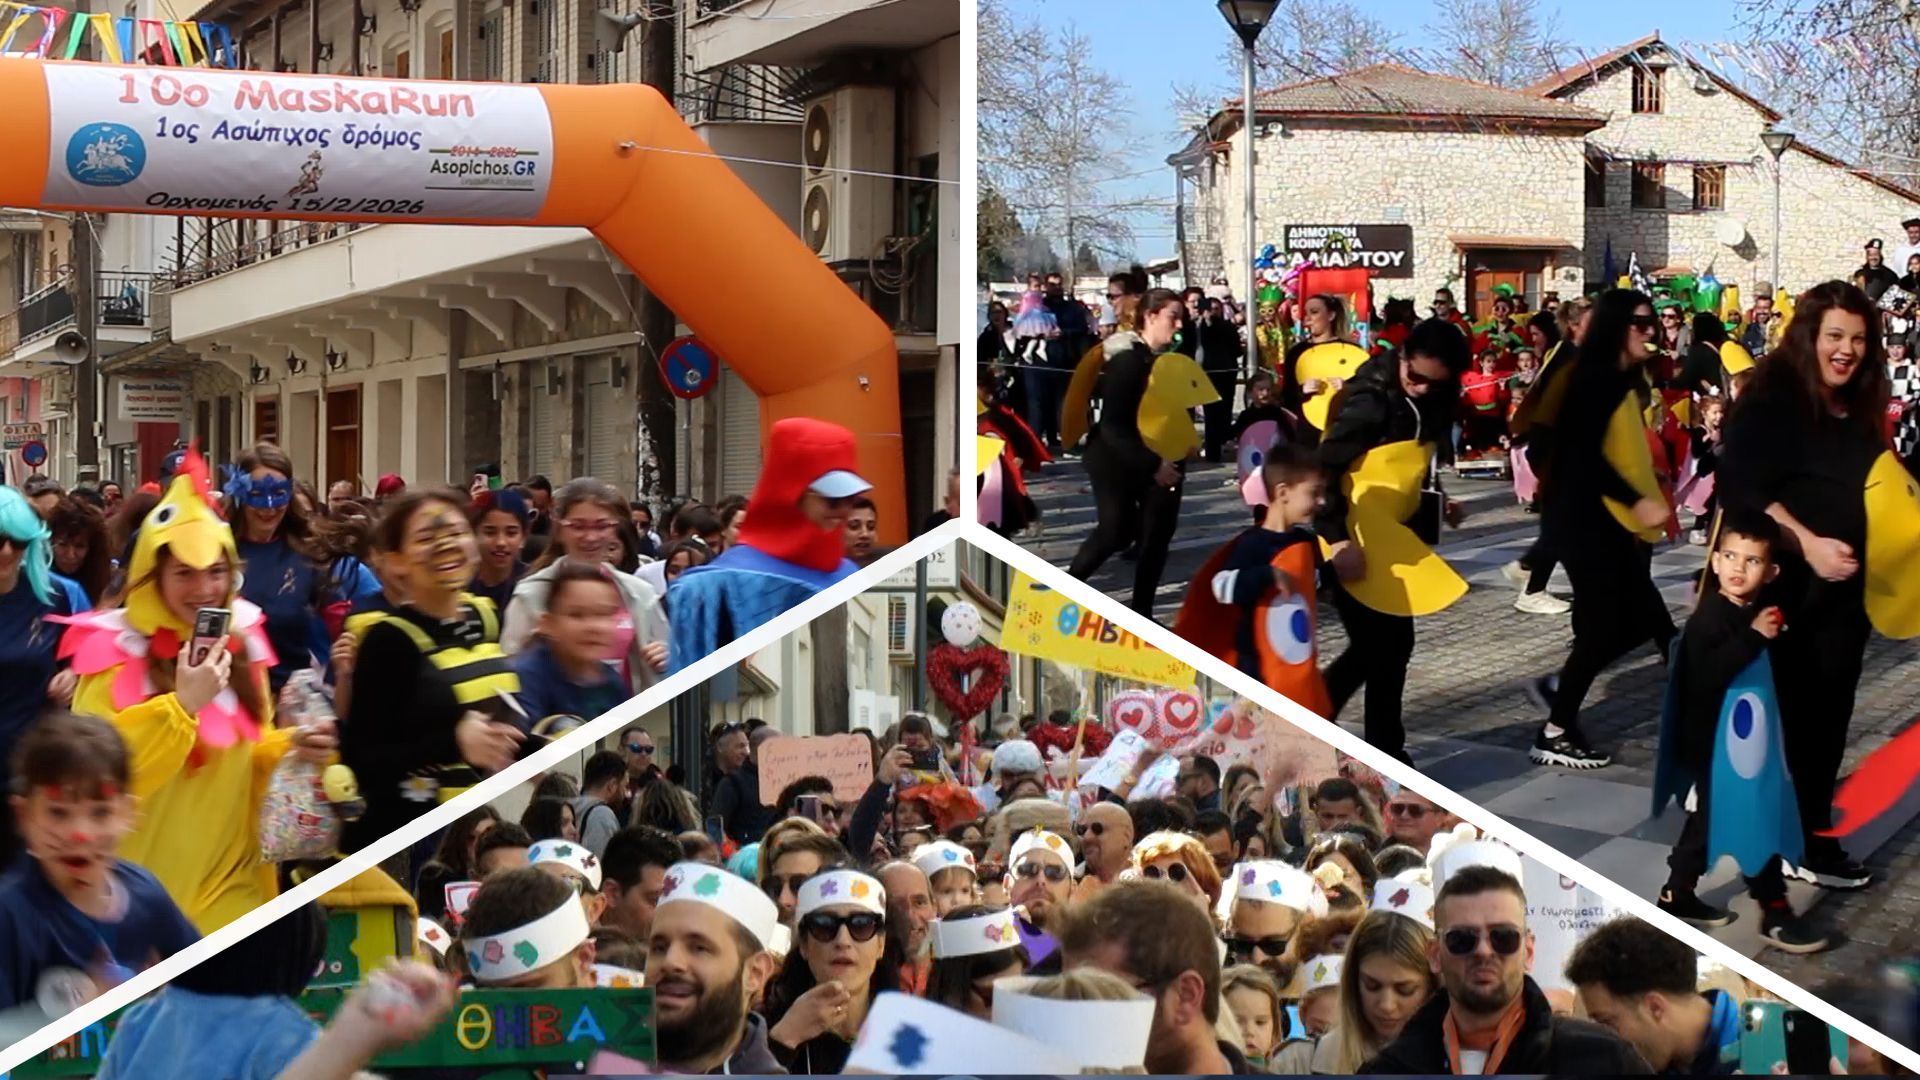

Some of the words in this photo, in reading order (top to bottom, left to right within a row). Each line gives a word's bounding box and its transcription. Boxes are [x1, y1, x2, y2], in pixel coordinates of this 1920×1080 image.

[233, 79, 475, 118] MaskaRun
[211, 119, 331, 148] Ασώπιχος
[341, 123, 422, 150] δρόμος
[430, 159, 536, 177] Asopichos.GR
[145, 191, 279, 212] Ορχομενός
[287, 197, 425, 215] 15/2/2026
[1289, 238, 1363, 249] ΚΟΙΝΟΑ
